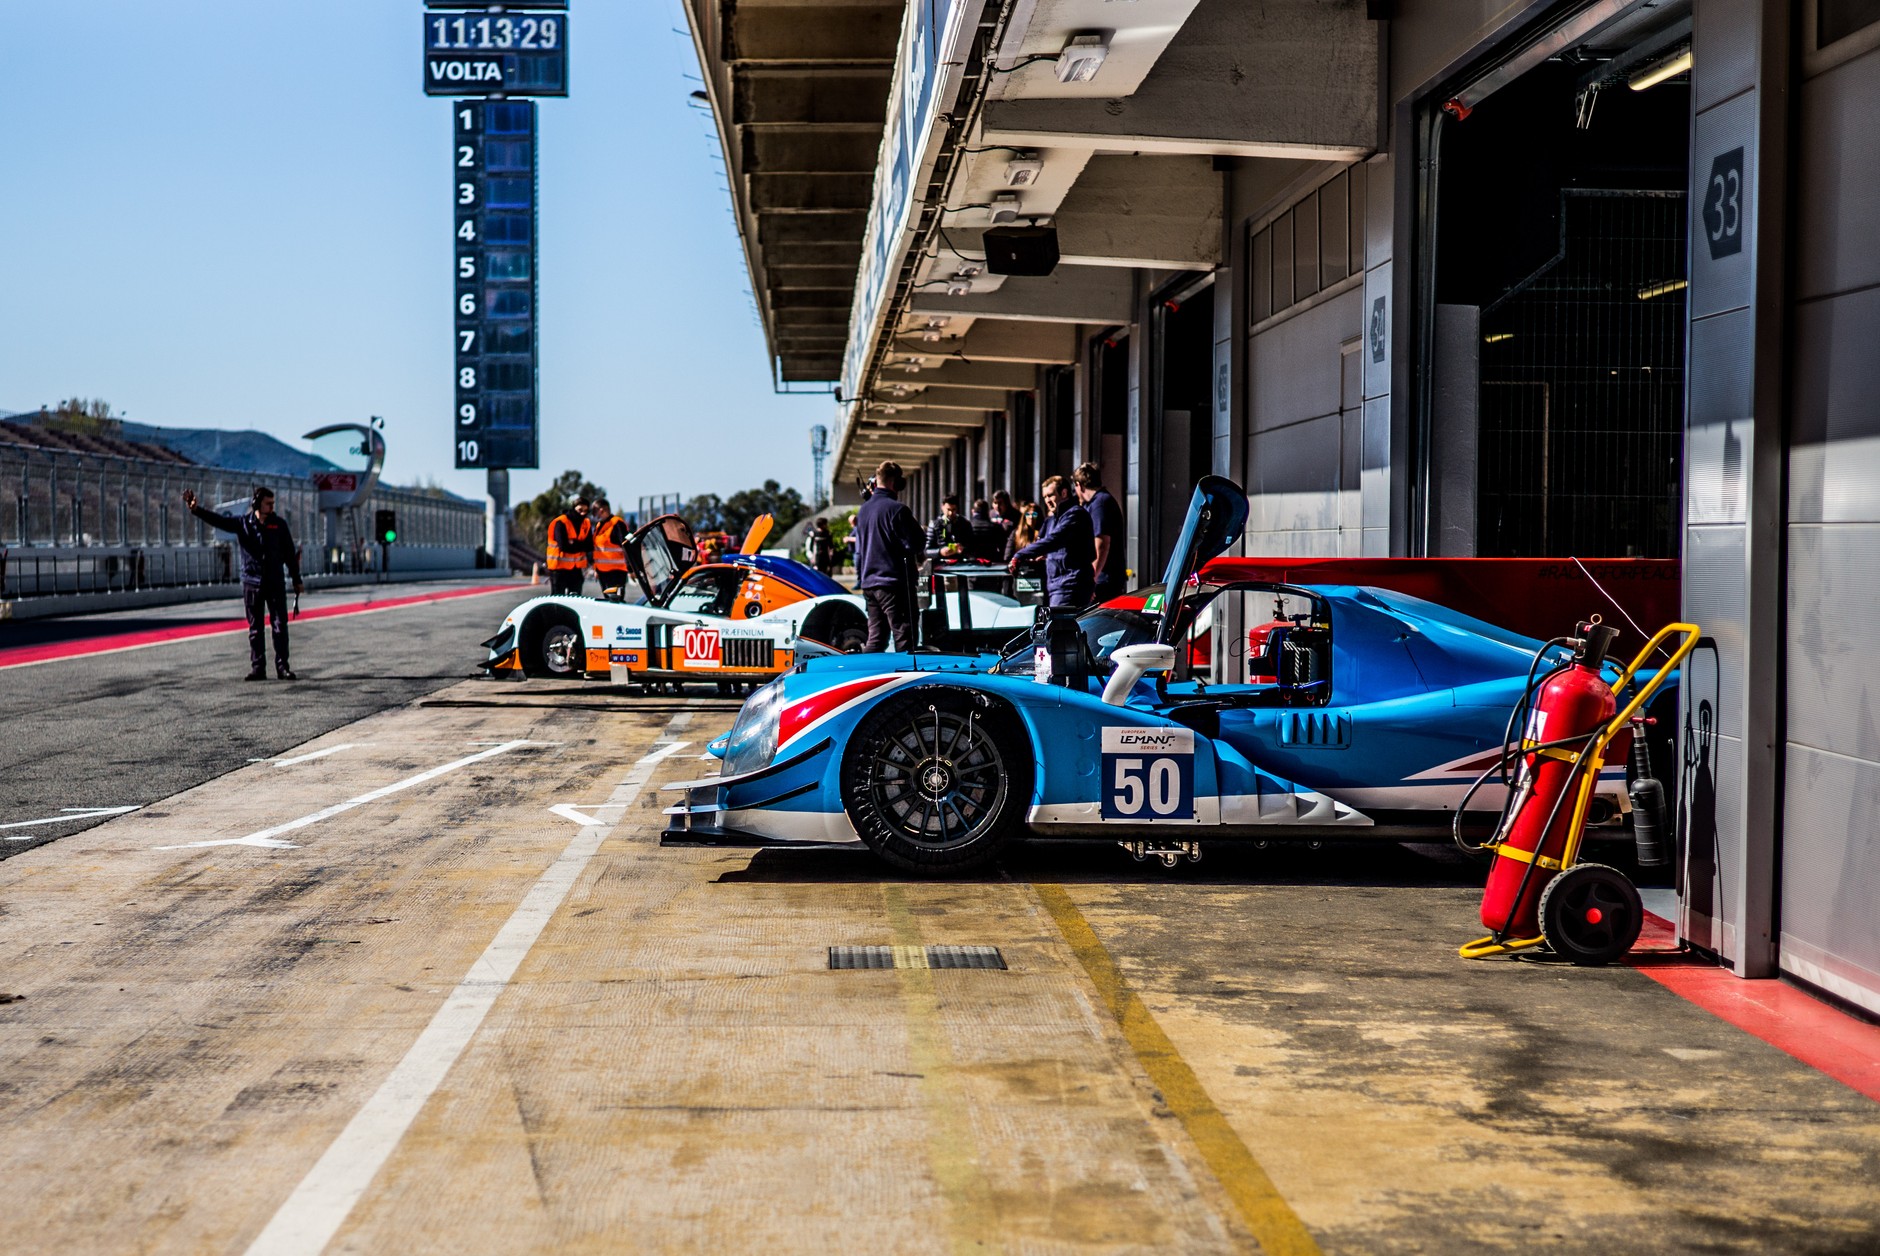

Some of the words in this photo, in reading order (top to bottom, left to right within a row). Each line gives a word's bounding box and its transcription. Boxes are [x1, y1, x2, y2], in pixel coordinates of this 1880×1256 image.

[433, 18, 557, 48] 11:13:29
[430, 61, 503, 81] VOLTA
[459, 109, 473, 130] 1
[458, 146, 475, 167] 2
[458, 183, 475, 204] 3
[1712, 168, 1740, 241] 33
[458, 220, 476, 241] 4
[459, 257, 476, 278] 5
[459, 294, 476, 315] 6
[1373, 309, 1385, 352] 34
[459, 331, 475, 352] 7
[459, 367, 476, 389] 8
[459, 404, 476, 425] 9
[458, 440, 478, 462] 10
[685, 630, 718, 659] 007
[1114, 757, 1180, 815] 50
